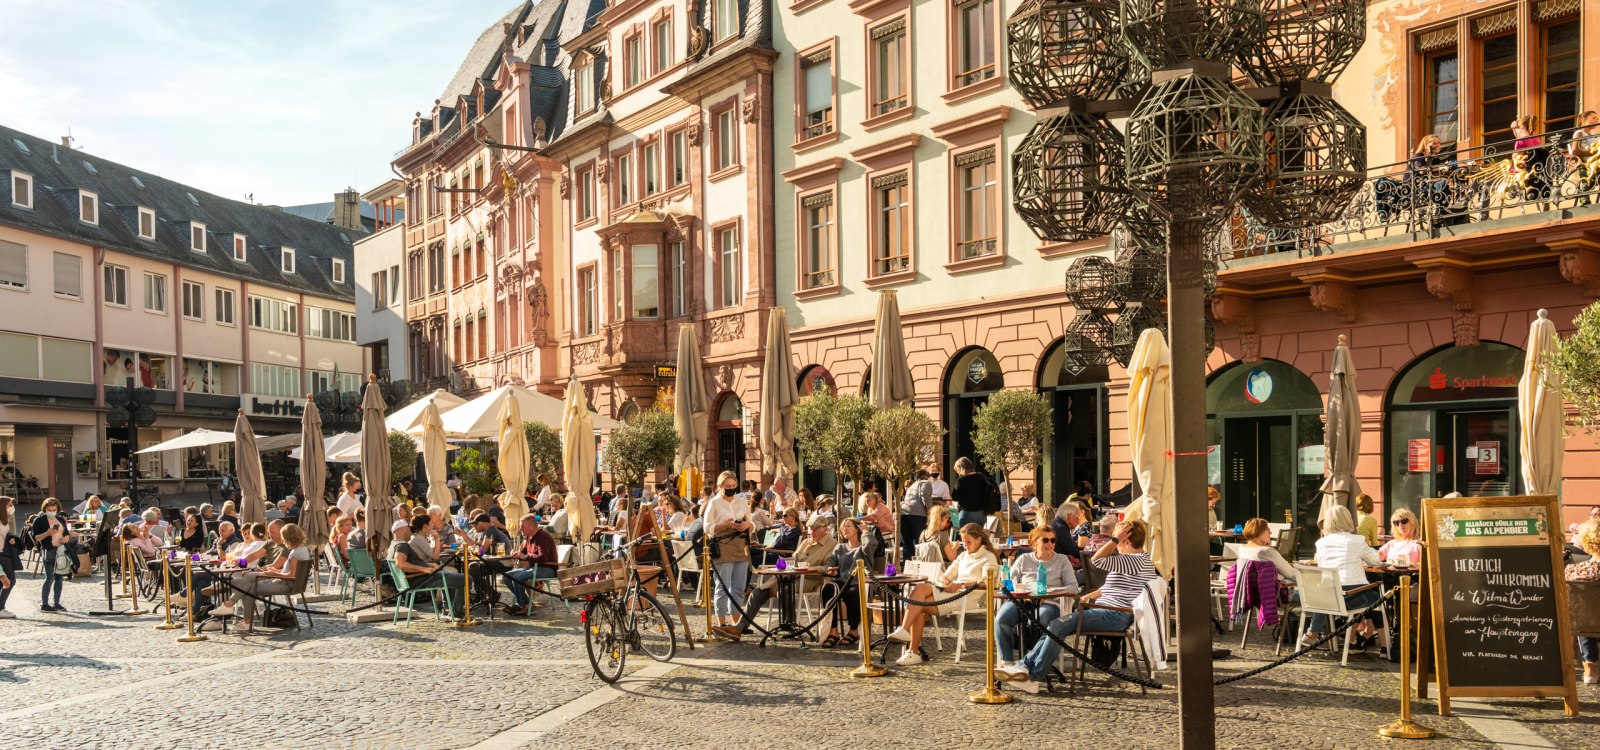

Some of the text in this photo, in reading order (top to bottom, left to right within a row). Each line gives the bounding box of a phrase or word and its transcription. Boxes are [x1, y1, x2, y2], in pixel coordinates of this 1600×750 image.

[1453, 375, 1517, 390] Sparkasse
[252, 397, 304, 416] buttle
[1483, 449, 1492, 461] 3
[1465, 526, 1528, 535] DAS ALPENBIER
[1454, 558, 1502, 572] HERZLICH
[1486, 573, 1550, 588] WILLKOMMEN
[1478, 626, 1539, 644] Haupteingang
